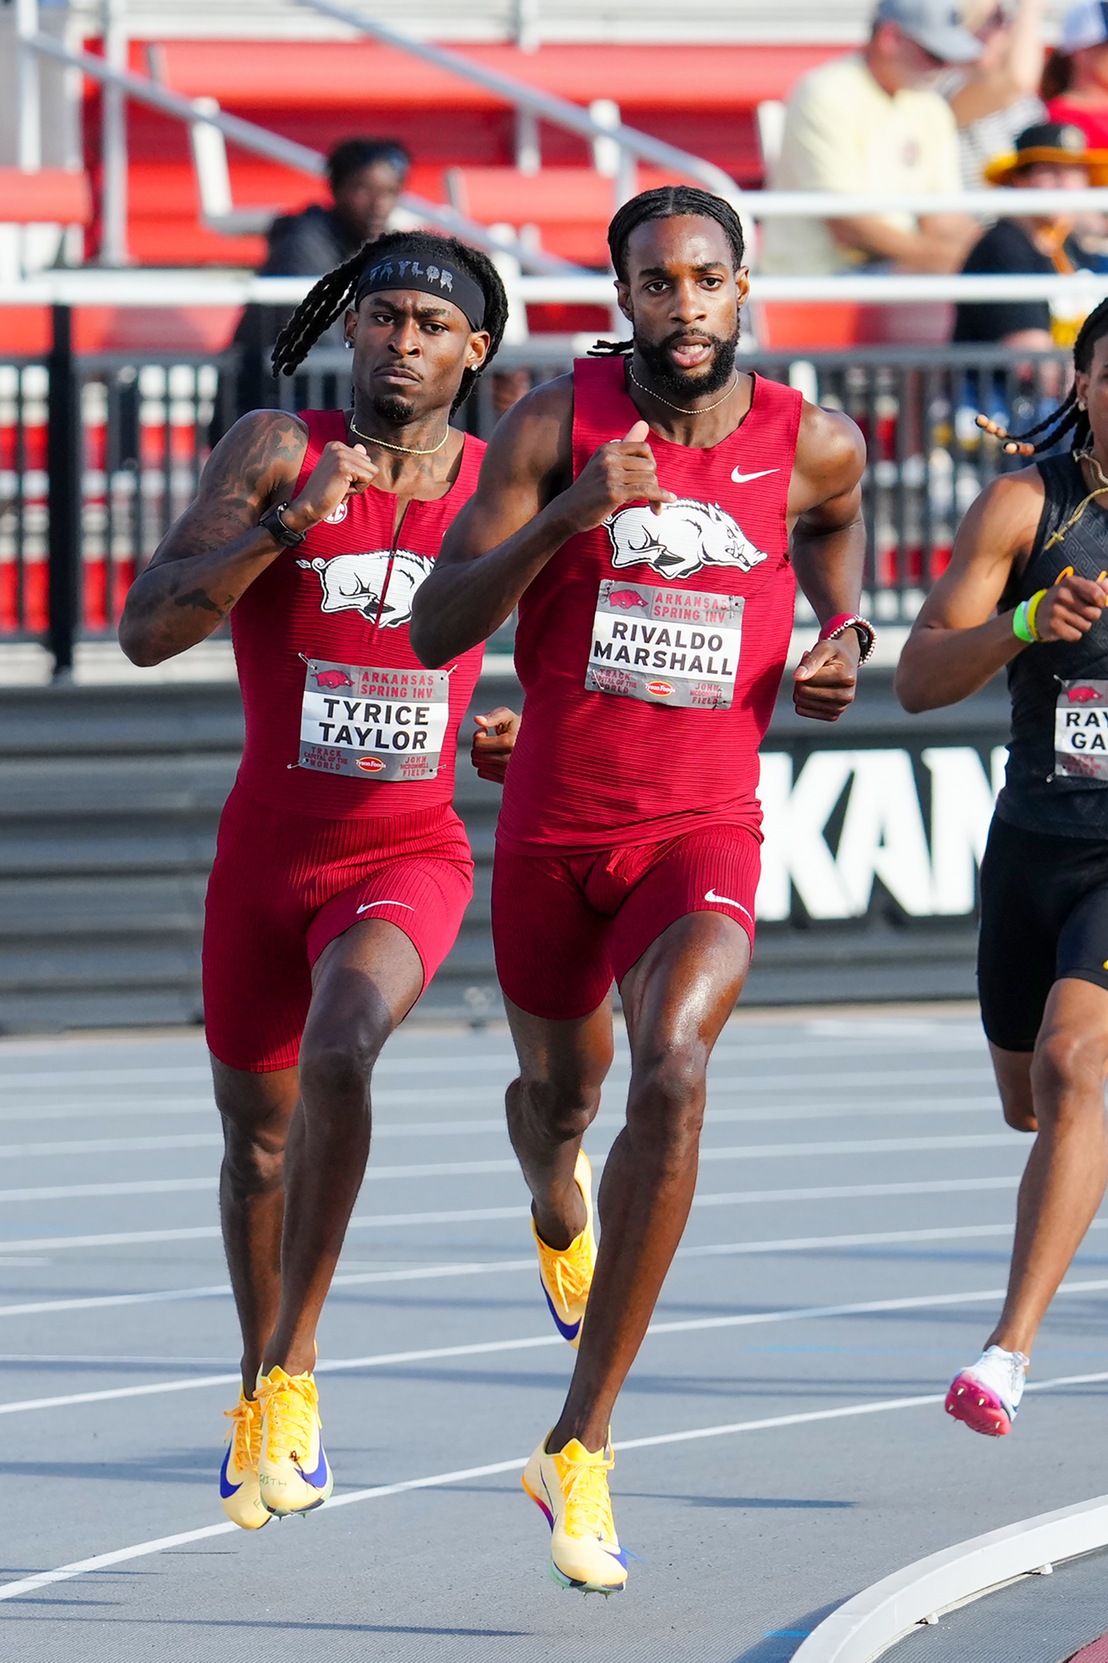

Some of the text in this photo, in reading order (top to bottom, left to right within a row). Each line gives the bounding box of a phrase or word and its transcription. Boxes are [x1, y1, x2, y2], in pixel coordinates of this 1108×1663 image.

[370, 261, 454, 293] TAYLOR
[655, 592, 727, 611] ARKANSAS
[653, 605, 726, 624] SPRING INV
[612, 621, 723, 652] RIVALDO
[593, 641, 733, 676] MARSHALL
[362, 671, 434, 686] ARKANSAS
[600, 668, 631, 681] TRACK
[360, 684, 433, 699] SPRING INV
[692, 697, 718, 705] FIELD
[323, 698, 430, 726] TYRICE
[319, 722, 428, 751] TAYLOR
[311, 746, 342, 758] TRACK
[310, 760, 341, 771] WORLD
[405, 756, 427, 764] JOHN
[403, 769, 426, 777] FIELD
